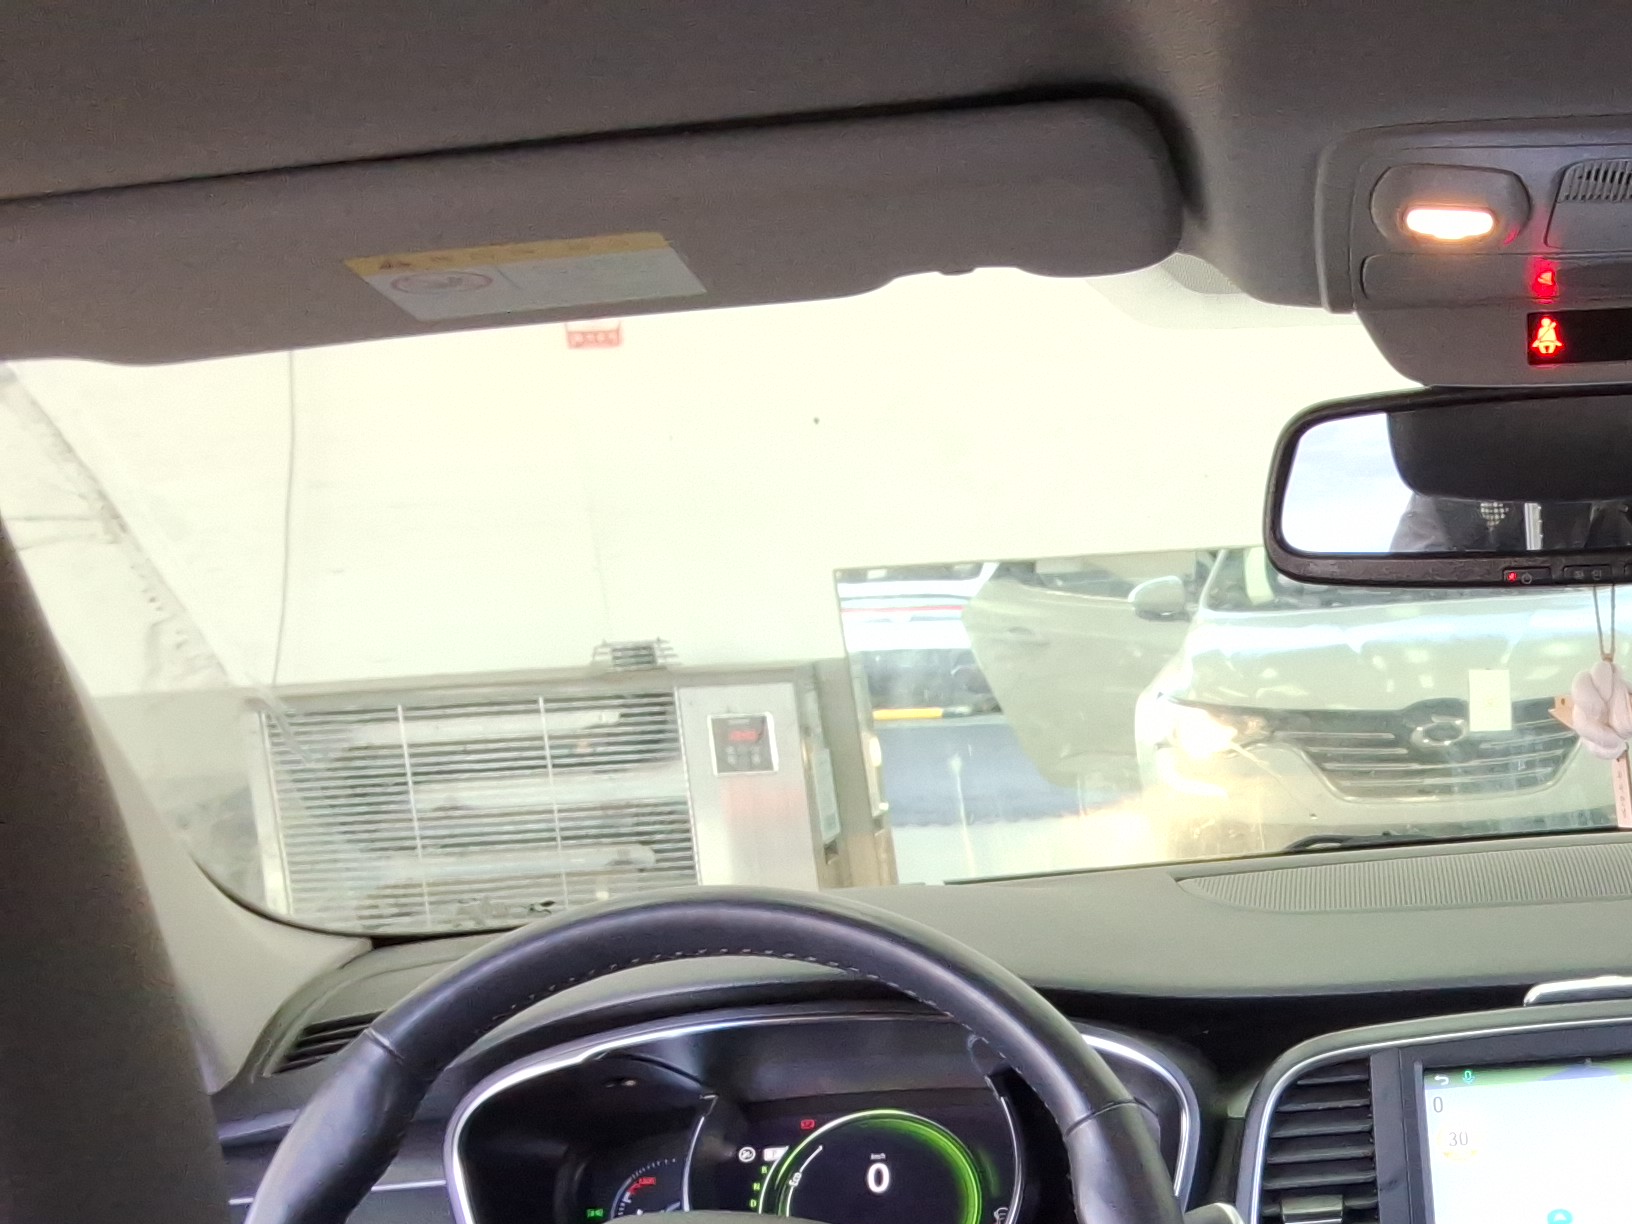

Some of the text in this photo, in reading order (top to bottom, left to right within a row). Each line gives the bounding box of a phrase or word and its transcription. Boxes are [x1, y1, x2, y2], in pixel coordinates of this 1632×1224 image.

[1433, 1096, 1444, 1113] 0
[1448, 1131, 1469, 1147] 30
[868, 1161, 890, 1194] 0
